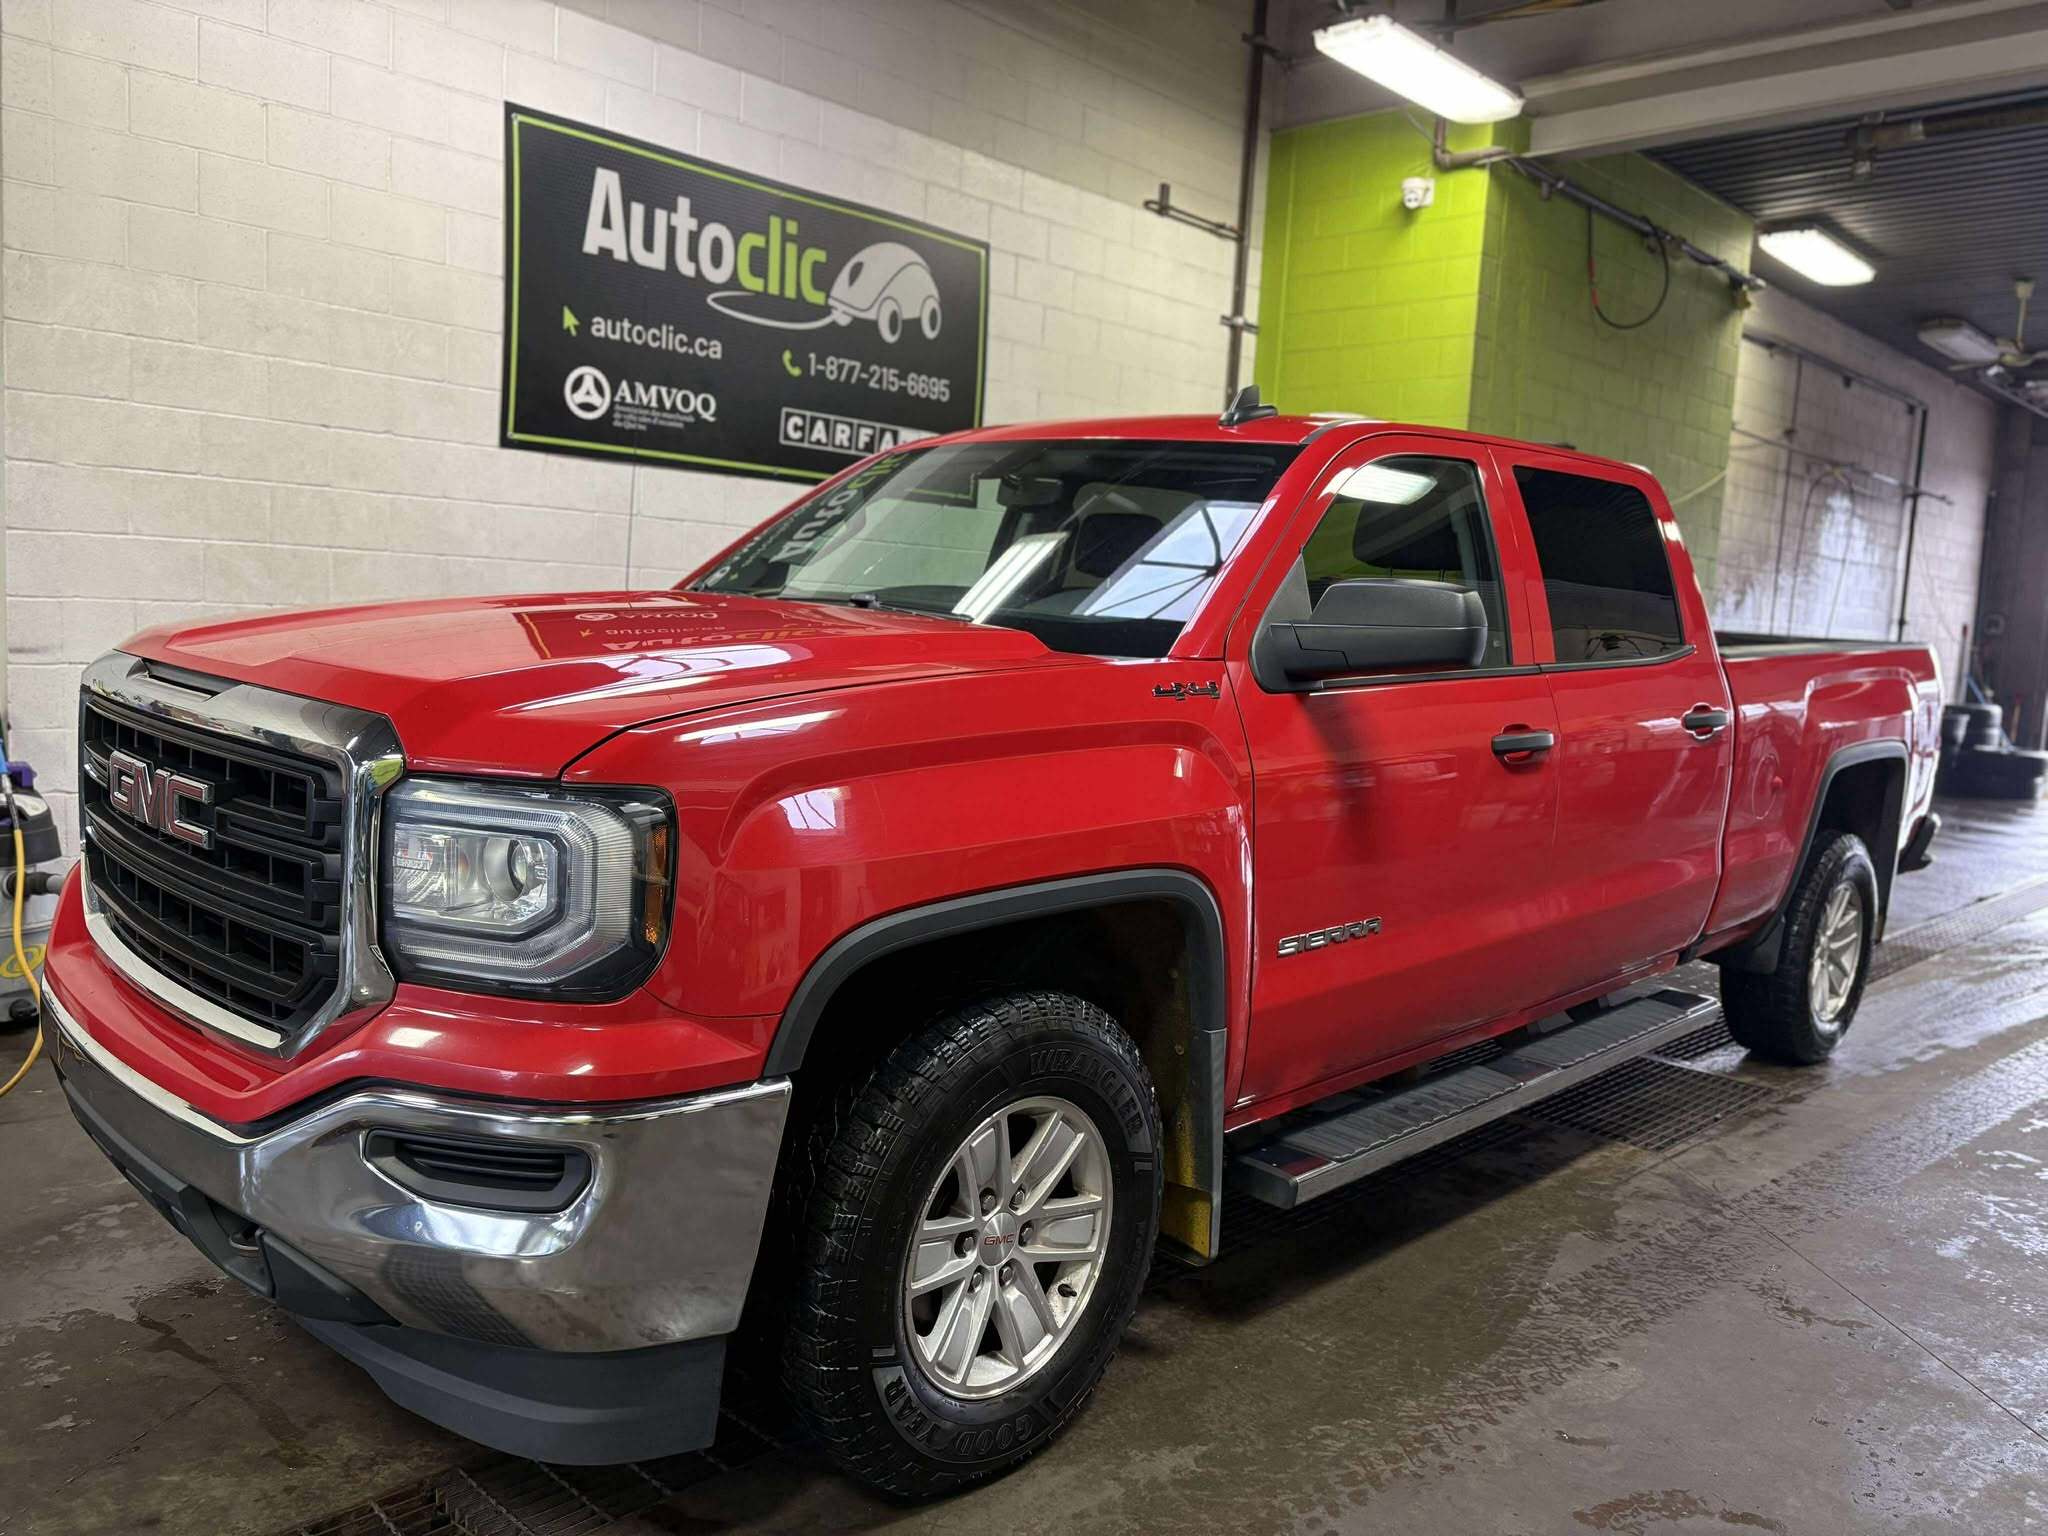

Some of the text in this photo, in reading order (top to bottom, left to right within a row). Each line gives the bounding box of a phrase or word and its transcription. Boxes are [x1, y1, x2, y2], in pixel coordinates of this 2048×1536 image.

[582, 166, 828, 306] Autoclic
[591, 316, 723, 360] autoclic.ca
[808, 352, 951, 402] 1-877-215-6695
[614, 379, 717, 422] AMVOQ
[785, 415, 908, 453] CARFA
[109, 750, 212, 850] GMC
[1277, 916, 1382, 958] SIERRA
[1029, 1047, 1144, 1137] WRANGLER
[983, 1233, 1015, 1246] GMC
